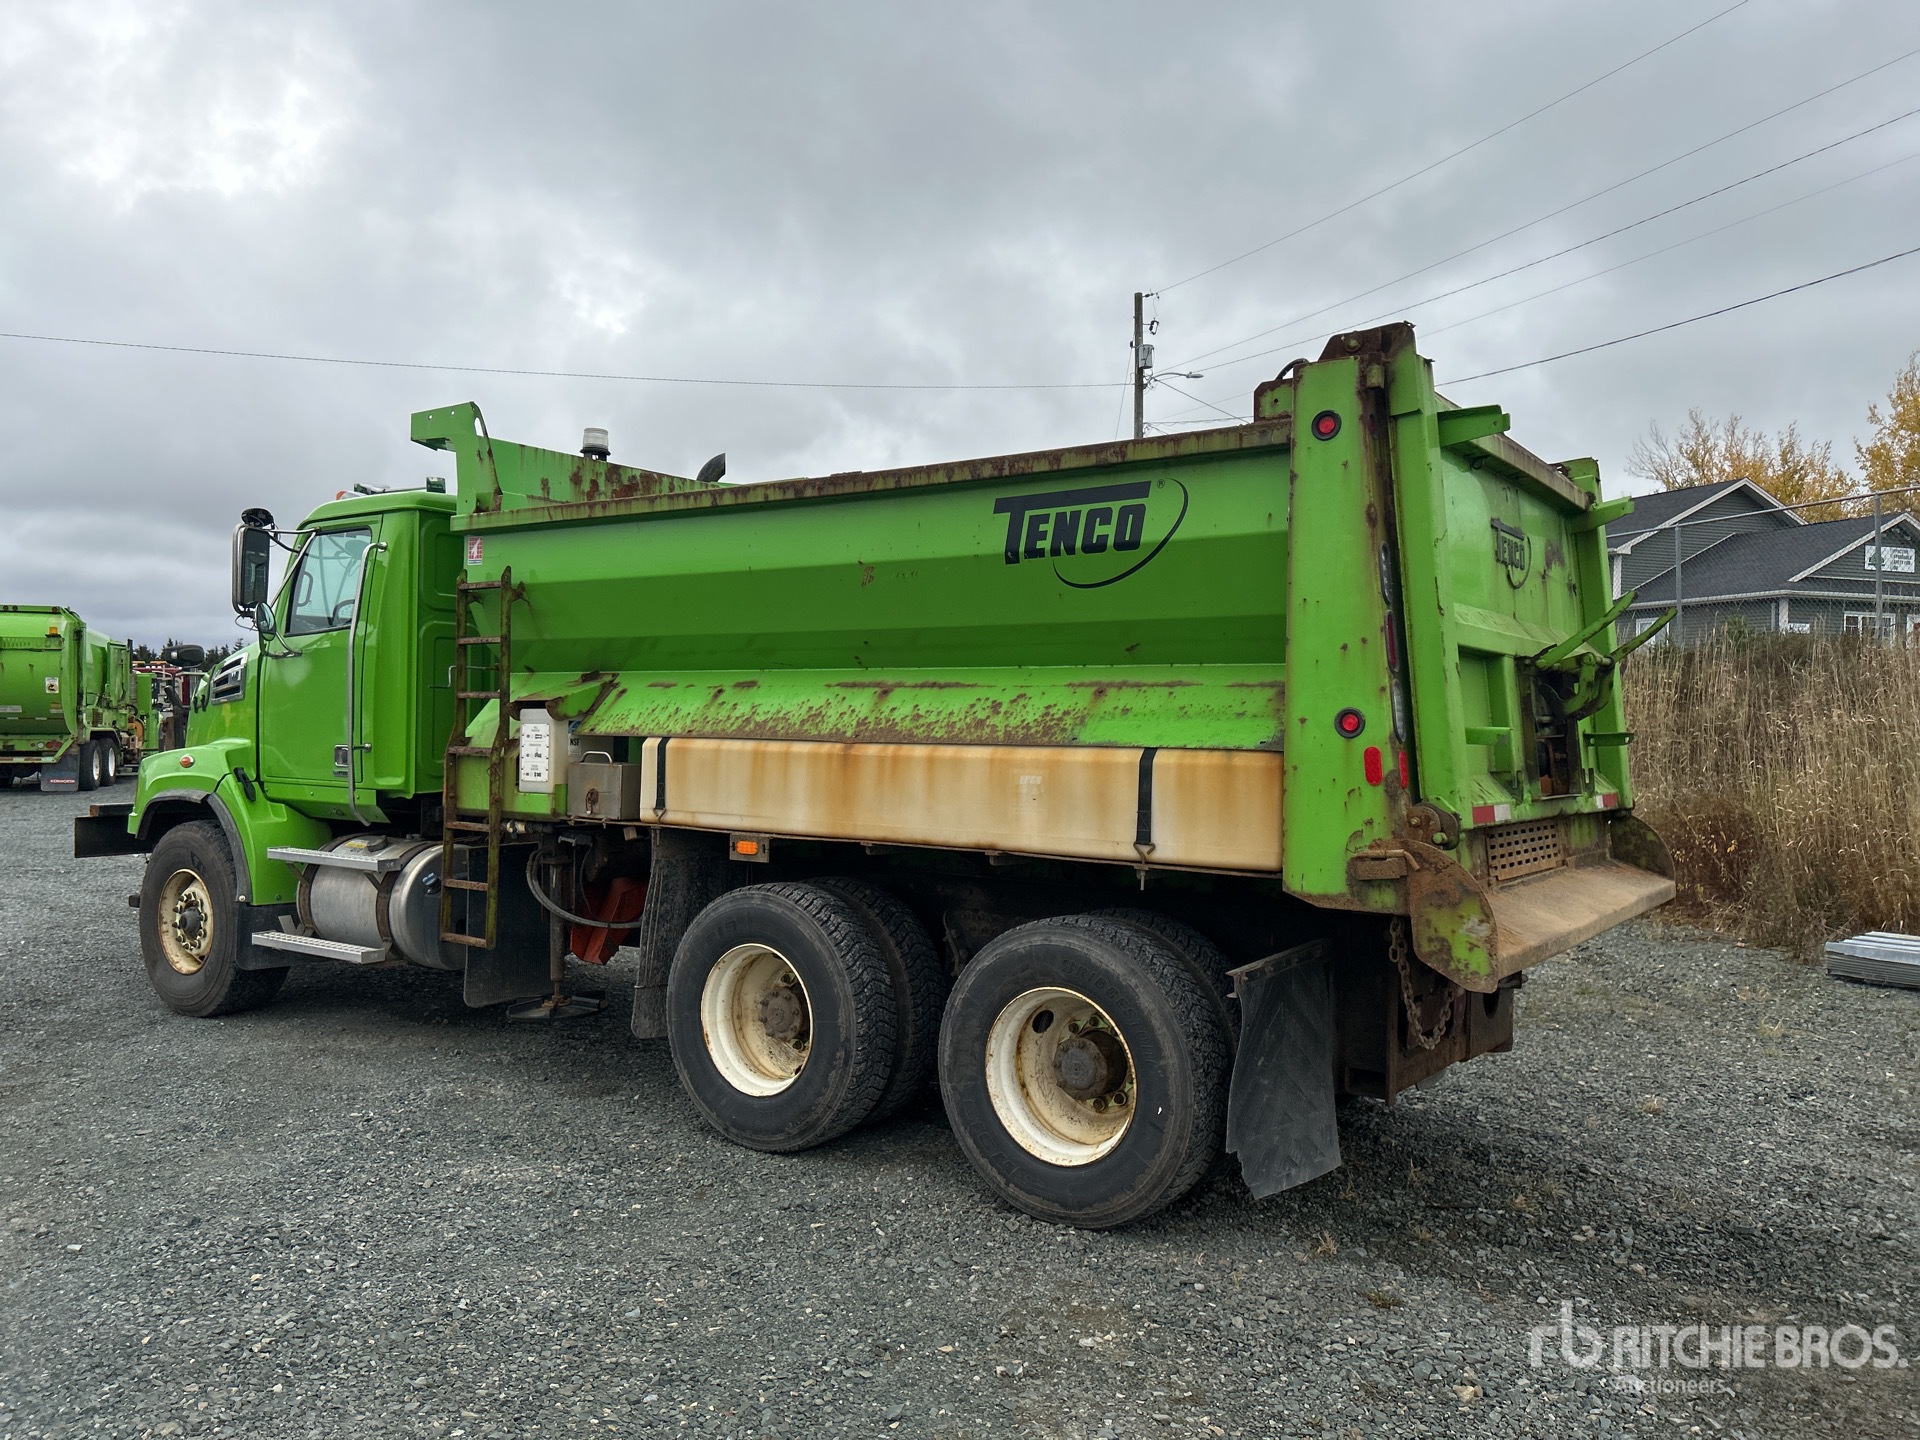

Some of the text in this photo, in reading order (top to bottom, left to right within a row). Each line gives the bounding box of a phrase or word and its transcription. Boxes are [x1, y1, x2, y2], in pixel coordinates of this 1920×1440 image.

[993, 480, 1151, 565] TENCO
[1491, 517, 1525, 571] TENCO
[570, 738, 580, 746] NSF
[1060, 959, 1158, 1064] BRIDGESTONE
